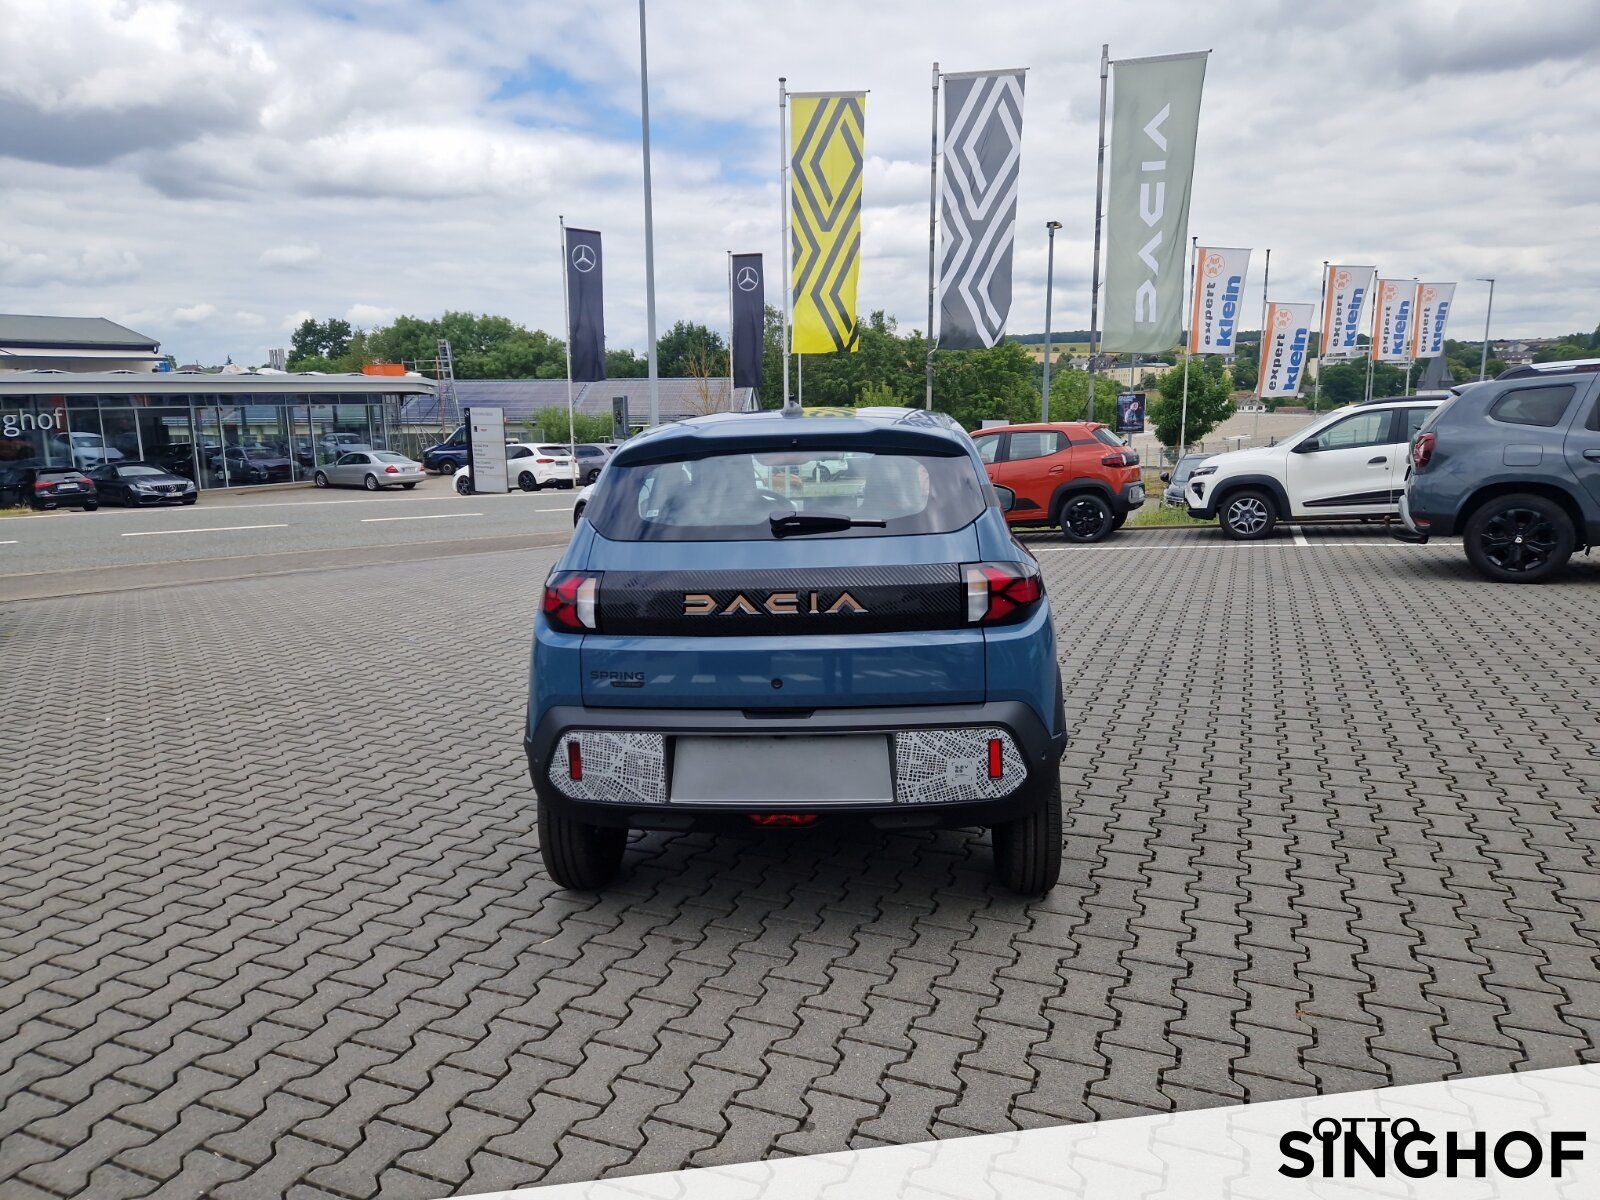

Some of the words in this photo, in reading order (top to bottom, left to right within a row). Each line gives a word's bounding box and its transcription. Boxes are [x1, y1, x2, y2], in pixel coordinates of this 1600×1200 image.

[1136, 103, 1170, 323] DACIA
[1204, 282, 1216, 346] expert
[1215, 276, 1241, 347] klein
[1332, 294, 1344, 347] expert
[1344, 288, 1364, 347] klein
[1382, 306, 1392, 354] expert
[1392, 300, 1410, 355] klein
[1421, 307, 1431, 353] expert
[1431, 302, 1448, 352] klein
[1268, 334, 1286, 391] expert
[1283, 328, 1308, 391] klein
[3, 407, 66, 436] ghof
[682, 591, 870, 616] DACIA
[590, 671, 645, 681] SPRING
